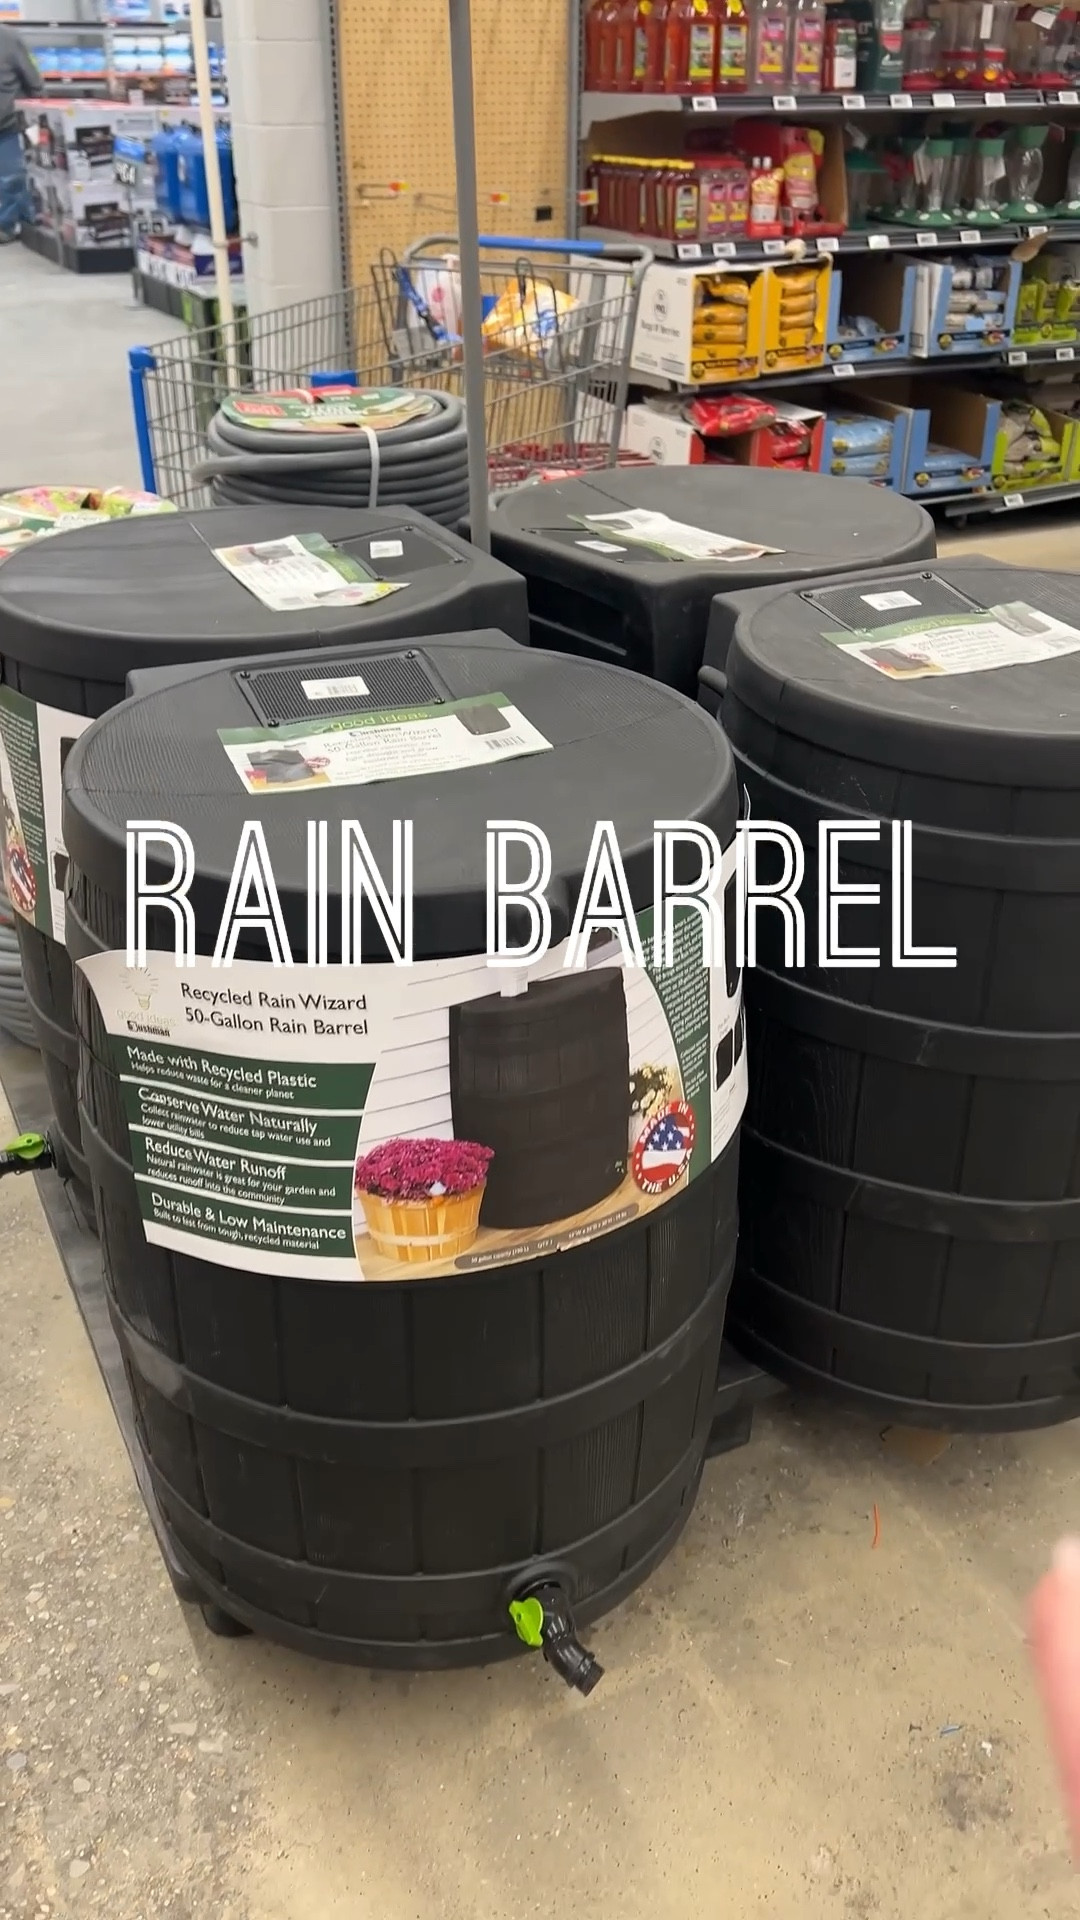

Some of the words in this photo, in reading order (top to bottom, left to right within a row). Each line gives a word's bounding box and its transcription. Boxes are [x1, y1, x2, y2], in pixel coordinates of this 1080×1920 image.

[331, 716, 376, 731] good
[180, 982, 252, 1007] Recycled
[259, 991, 296, 1009] Rain
[298, 994, 367, 1010] Wizard
[185, 1006, 263, 1031] 50-Gallon
[270, 1017, 307, 1034] Rain
[314, 1019, 368, 1035] Barrel
[126, 1045, 165, 1065] Made
[168, 1055, 198, 1071] with
[201, 1058, 262, 1083] Recycled
[268, 1070, 317, 1088] Plastic
[131, 1061, 155, 1075] Helps
[157, 1066, 184, 1080] reduce
[186, 1073, 209, 1086] waste
[210, 1077, 223, 1089] for
[232, 1083, 262, 1096] cleaner
[265, 1088, 294, 1100] planet
[138, 1086, 199, 1114] Conserve
[200, 1101, 245, 1124] Water
[250, 1111, 318, 1137] Naturally
[141, 1103, 169, 1119] Collect
[171, 1110, 206, 1128] rainwater
[208, 1121, 218, 1131] to
[219, 1123, 249, 1137] reduce
[251, 1129, 265, 1141] tap
[267, 1131, 293, 1144] water
[295, 1136, 311, 1147] use
[313, 1137, 331, 1147] and
[141, 1116, 165, 1129] lower
[166, 1121, 188, 1137] utility
[189, 1128, 205, 1140] bills
[639, 1104, 672, 1144] MADE
[677, 1102, 690, 1115] IN
[145, 1137, 193, 1161] Reduce
[193, 1147, 237, 1171] Water
[240, 1159, 287, 1181] Runoff
[146, 1154, 176, 1169] Natural
[177, 1161, 214, 1178] rainwater
[215, 1171, 222, 1180] is
[224, 1172, 246, 1187] great
[248, 1176, 260, 1189] for
[262, 1182, 282, 1196] your
[284, 1184, 316, 1198] garden
[318, 1187, 336, 1197] and
[147, 1168, 177, 1183] reduces
[179, 1174, 204, 1189] runoff
[204, 1180, 221, 1192] into
[222, 1185, 236, 1196] the
[237, 1188, 286, 1206] community
[641, 1178, 663, 1194] THE
[151, 1192, 201, 1219] Durable
[205, 1207, 215, 1220] &
[219, 1210, 249, 1229] Low
[252, 1216, 347, 1240] Maintenance
[172, 1213, 181, 1223] to
[197, 1219, 216, 1234] from
[218, 1225, 244, 1241] tough,
[244, 1231, 280, 1247] recycled
[282, 1236, 320, 1250] material
